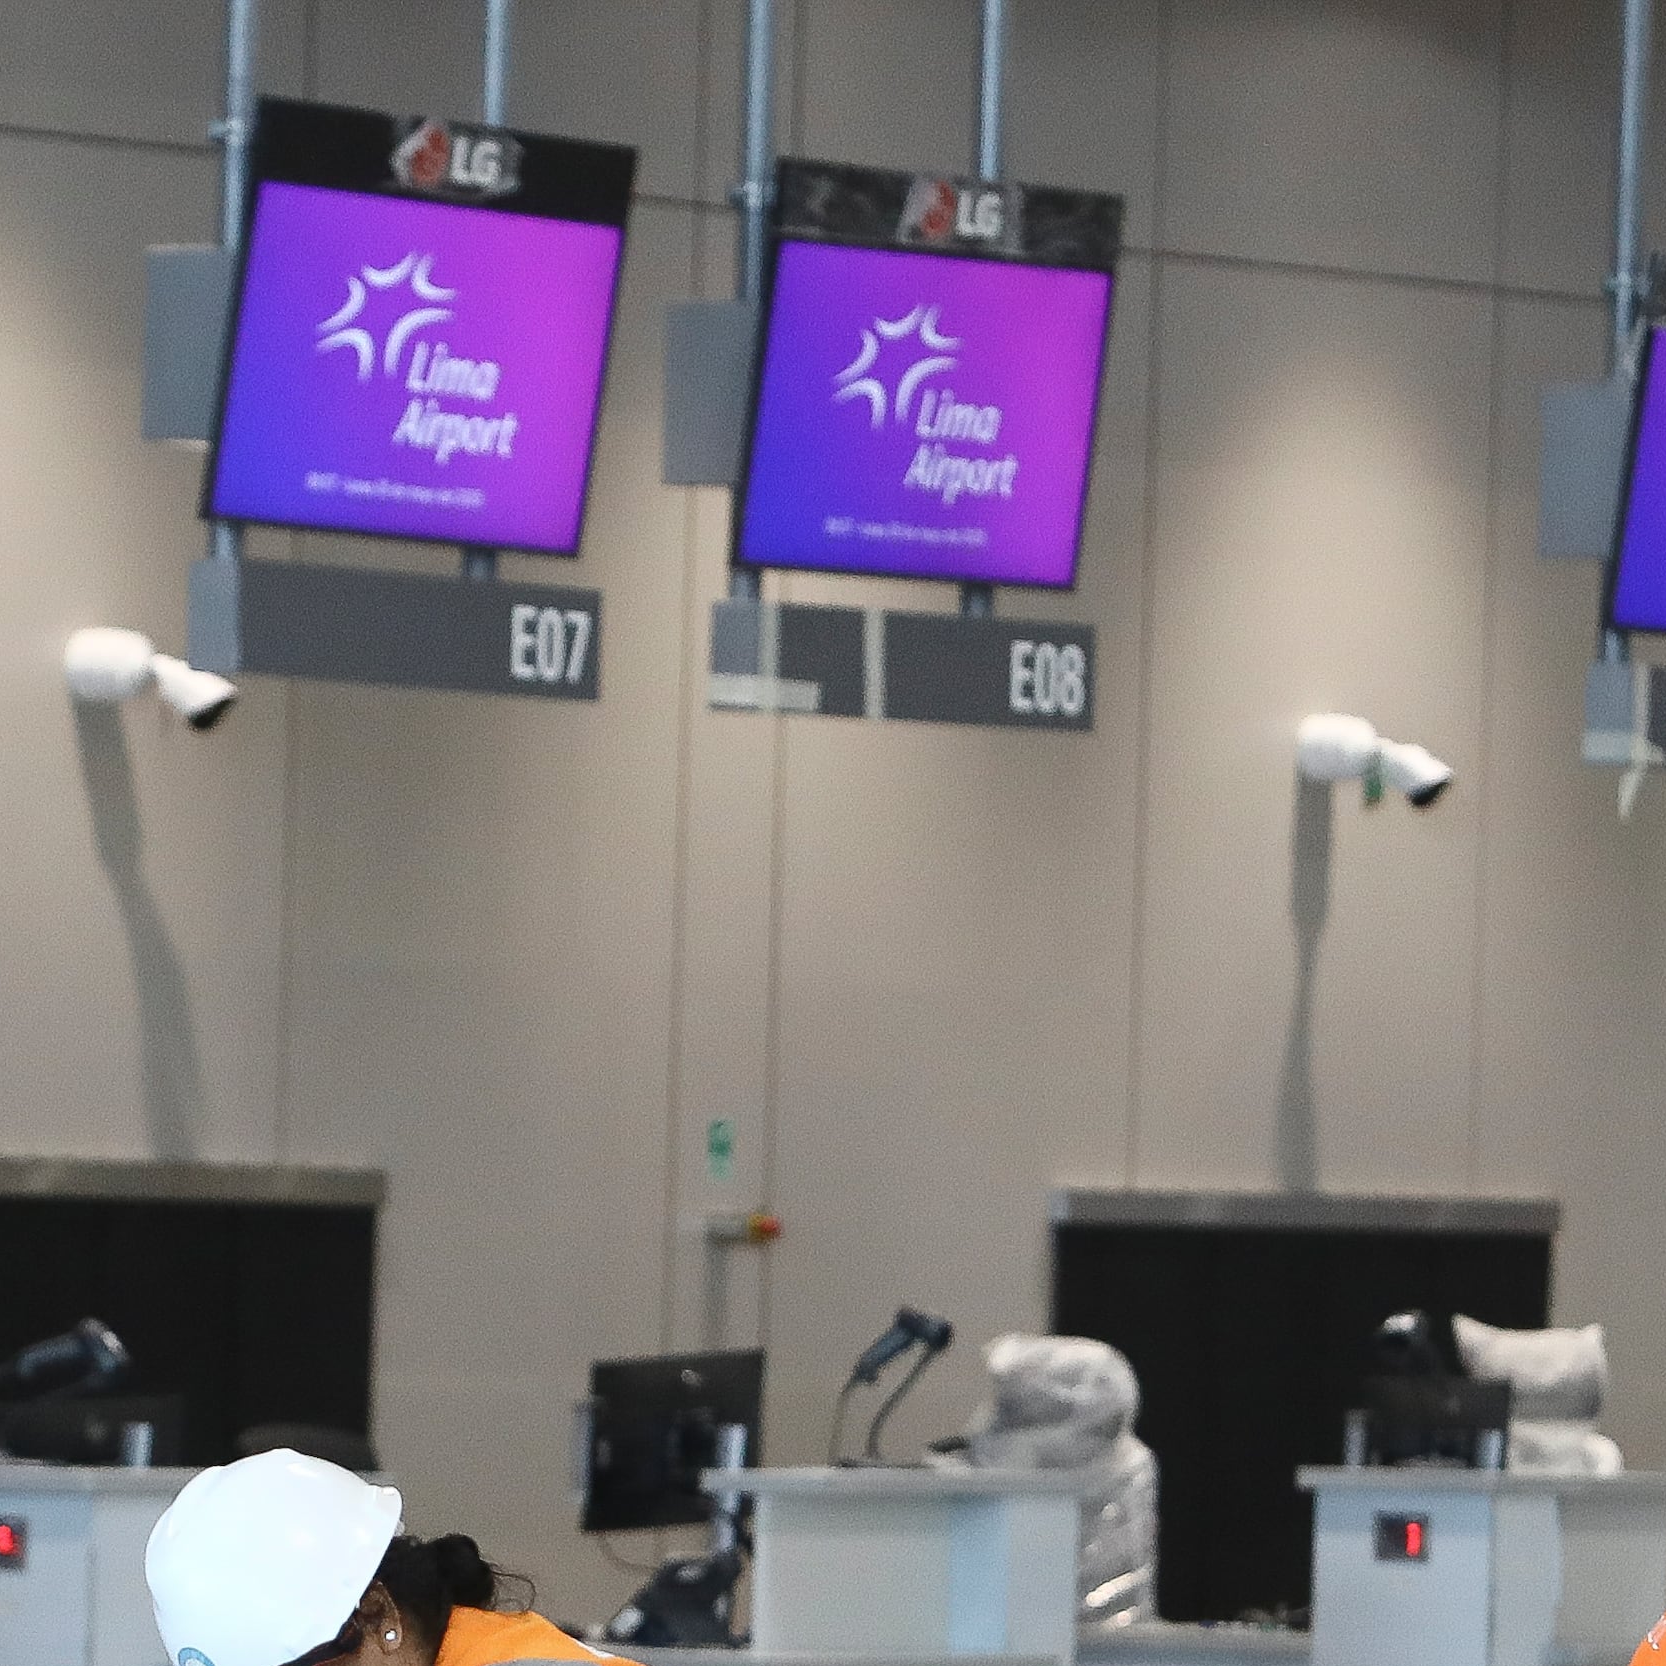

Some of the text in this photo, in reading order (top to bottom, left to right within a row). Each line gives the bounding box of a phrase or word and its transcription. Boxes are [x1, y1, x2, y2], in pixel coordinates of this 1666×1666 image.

[450, 137, 501, 188] LG
[956, 190, 1005, 239] LG
[404, 341, 500, 402] Lima
[392, 398, 520, 466] Airport
[916, 388, 1003, 442] Lima
[903, 442, 1020, 507] Airport
[509, 602, 591, 684] E07
[1008, 638, 1087, 716] E08
